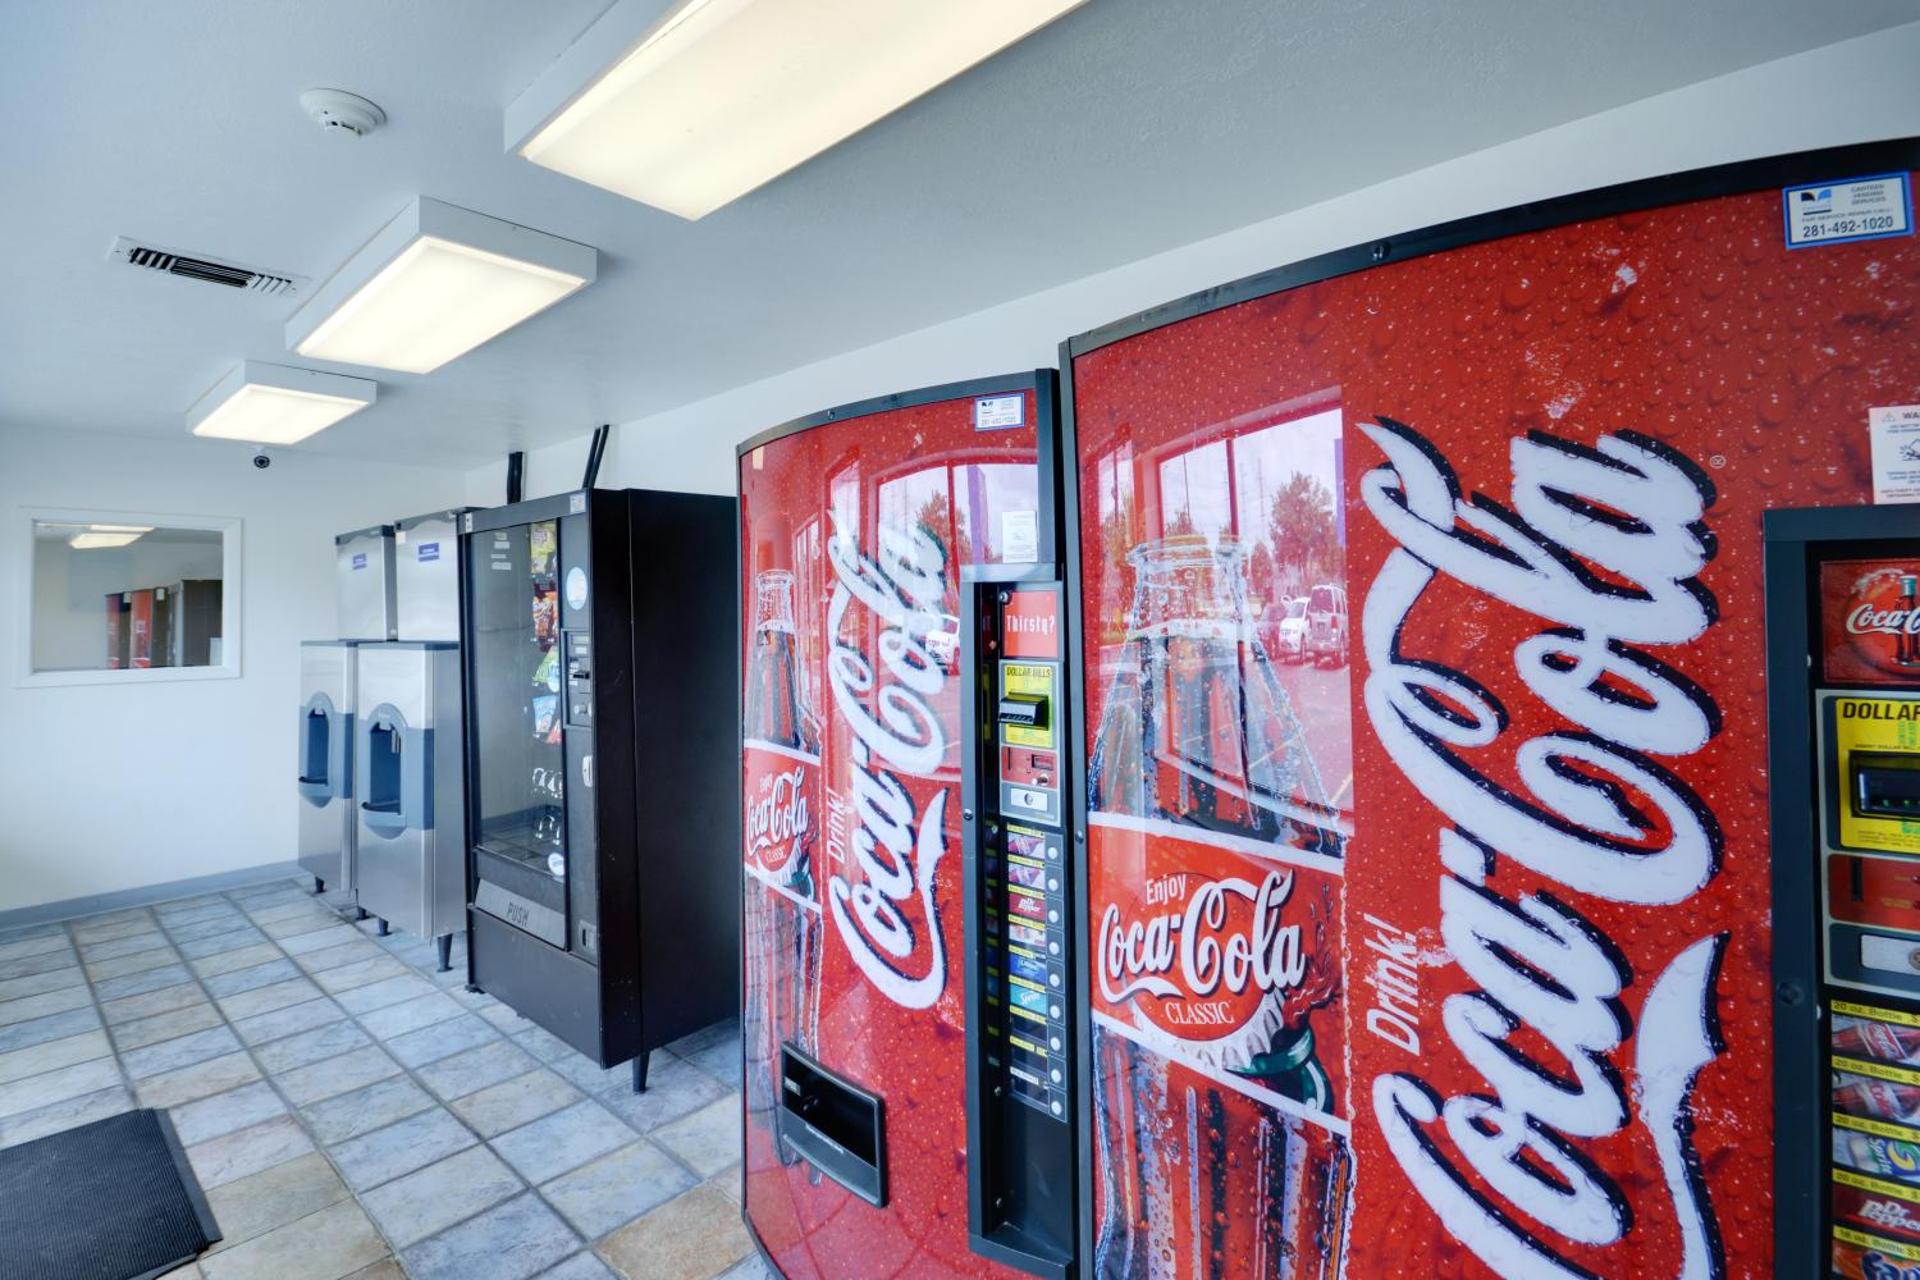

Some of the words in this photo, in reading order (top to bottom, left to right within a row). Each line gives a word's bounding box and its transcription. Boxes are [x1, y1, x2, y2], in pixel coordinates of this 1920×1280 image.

[1803, 215, 1894, 238] 281-492-1020
[1902, 410, 1920, 420] WA
[1006, 615, 1056, 636] Thirsty?
[827, 508, 948, 1010] Coca-Cola
[746, 766, 808, 857] Coca-Cola
[827, 787, 847, 864] Drink!
[1356, 419, 1730, 1280] Coca-Cola
[1146, 874, 1188, 906] Enjoy
[507, 901, 529, 928] PUSH
[1098, 868, 1306, 1000] Coca-Cola
[1364, 912, 1421, 1057] Drink!
[1165, 1000, 1235, 1026] CLASSIC
[1858, 1199, 1920, 1232] Peppe
